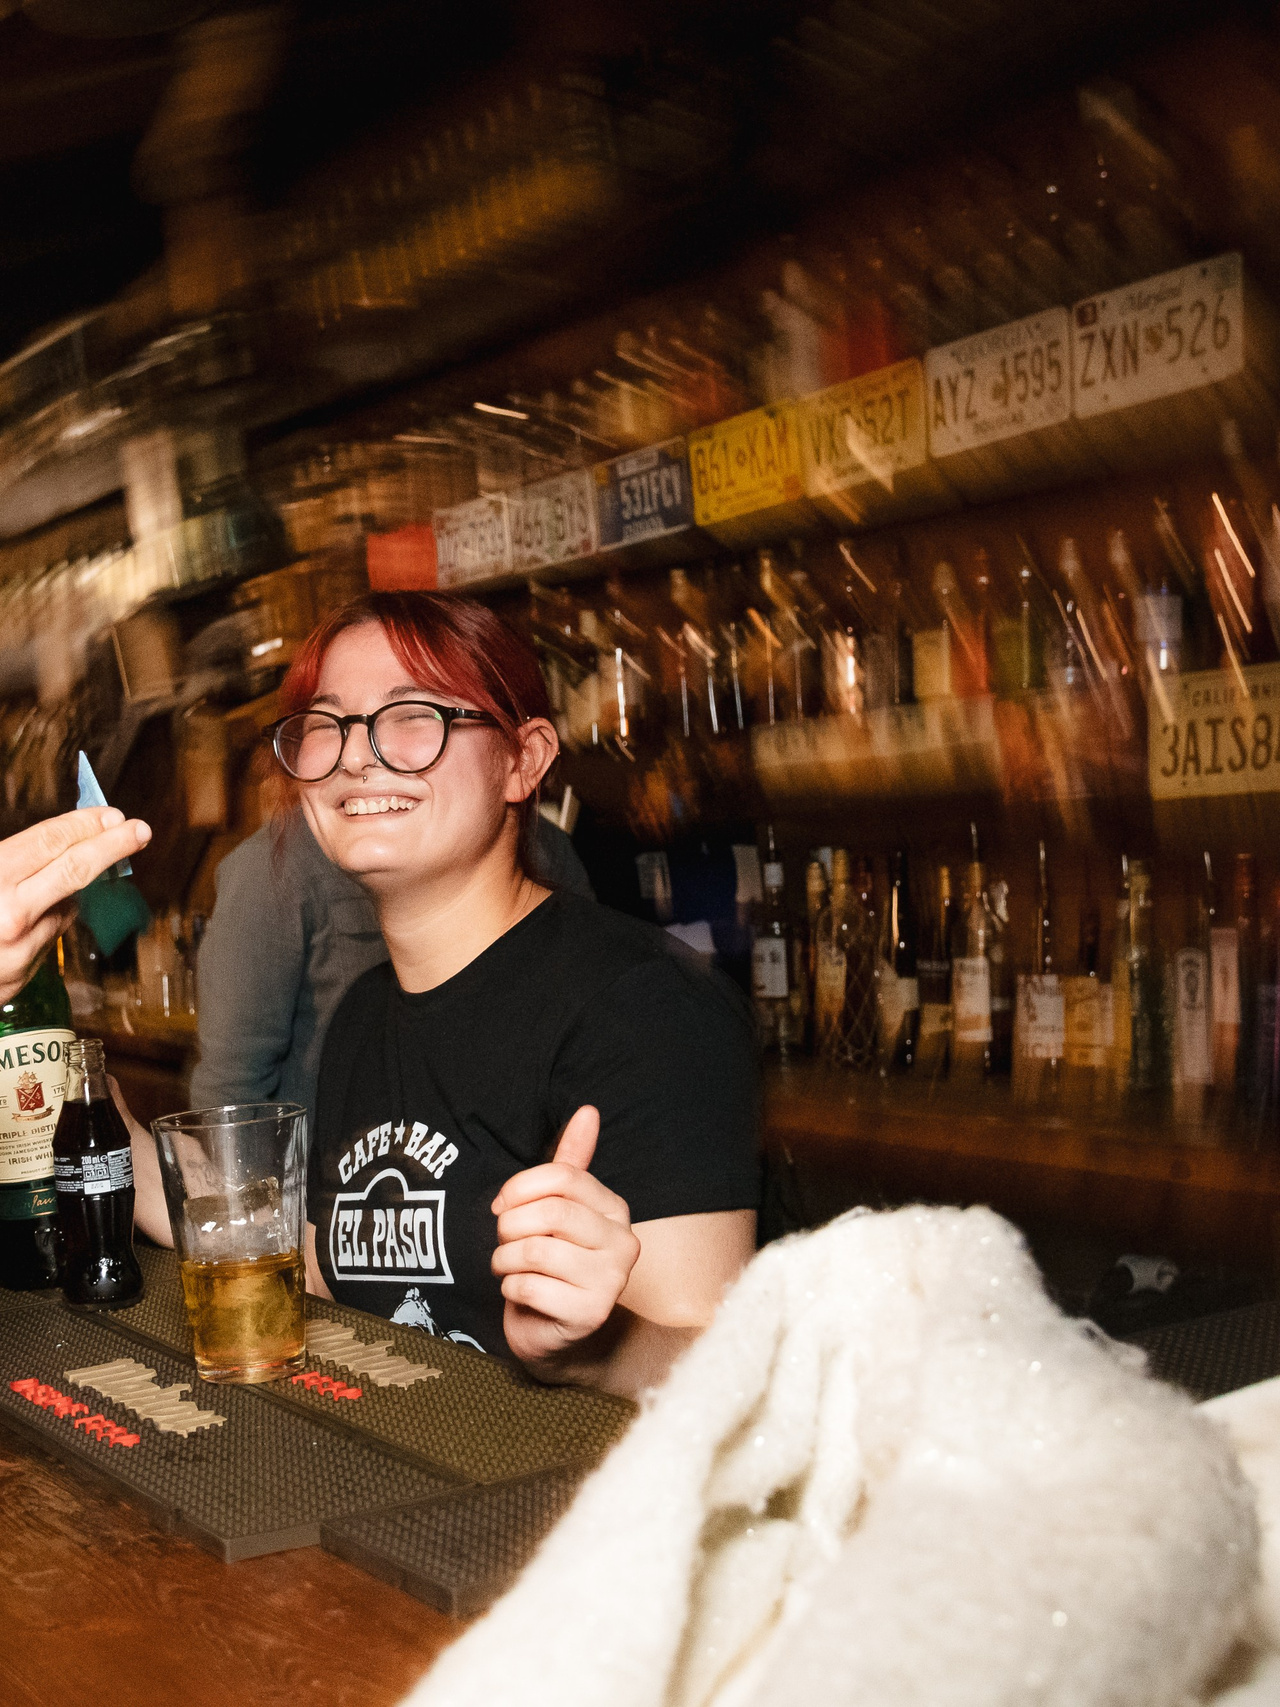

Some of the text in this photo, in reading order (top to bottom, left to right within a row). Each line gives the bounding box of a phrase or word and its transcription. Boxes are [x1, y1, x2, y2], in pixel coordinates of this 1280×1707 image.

[1078, 295, 1232, 390] ZXN 526
[1160, 713, 1280, 778] 3AIS8
[8, 1157, 32, 1165] IRISH
[35, 1151, 53, 1160] WHI
[81, 1156, 92, 1165] 200
[92, 1155, 100, 1164] ml
[337, 1121, 459, 1184] CAFE BAR
[337, 1207, 437, 1270] EL PASO
